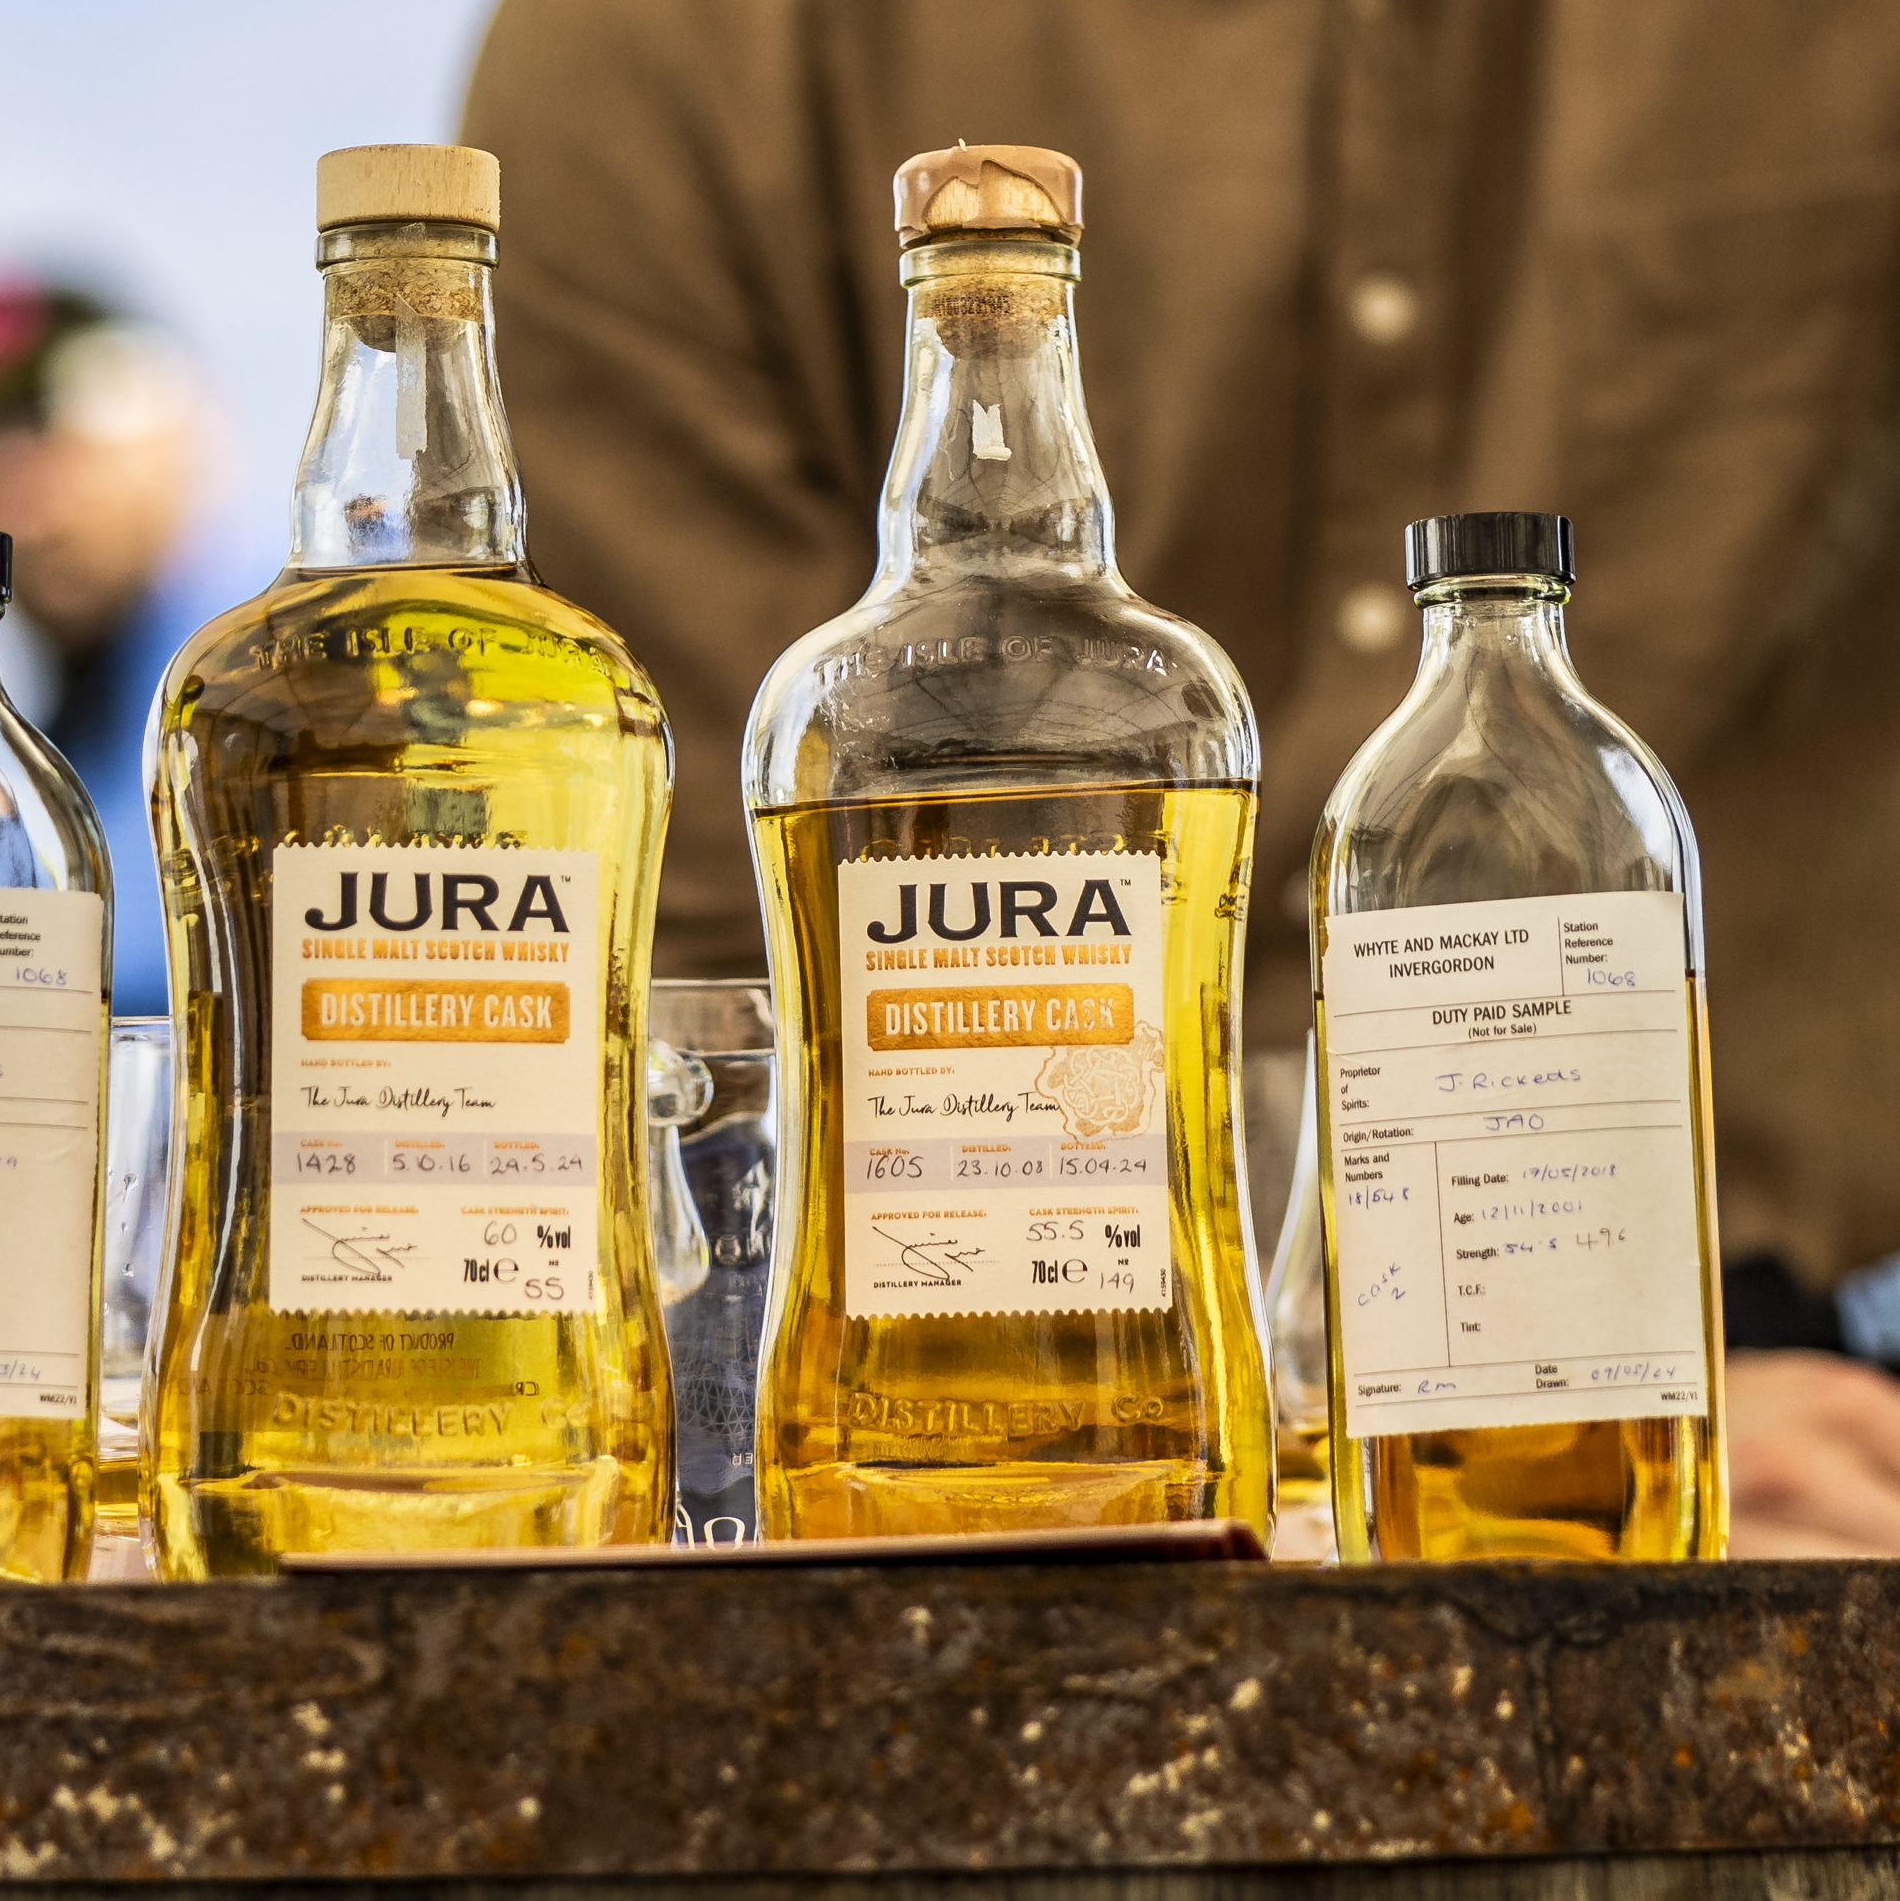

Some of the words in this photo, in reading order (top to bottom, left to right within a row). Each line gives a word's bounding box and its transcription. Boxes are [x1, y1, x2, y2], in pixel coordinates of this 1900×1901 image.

[346, 626, 430, 659] ISLE
[448, 626, 497, 654] OF
[900, 635, 992, 666] ISLE
[1005, 634, 1057, 663] OF
[304, 871, 570, 933] JURA
[867, 879, 1132, 944] JURA
[1563, 921, 1599, 932] Station
[1354, 940, 1399, 958] WHYTE
[1404, 936, 1435, 953] AND
[1439, 931, 1499, 950] MACKAY
[1504, 929, 1529, 945] LTD
[1565, 936, 1613, 948] Reference
[302, 938, 366, 959] SINGLE
[372, 939, 420, 960] MALT
[426, 940, 495, 961] SCOTCH
[501, 941, 570, 962] WHISKY
[866, 949, 927, 971] SINGLE
[934, 948, 980, 969] MALT
[986, 946, 1056, 967] SCOTCH
[1063, 944, 1132, 966] WHISKY
[1566, 953, 1608, 964] Number:
[1389, 956, 1495, 979] INVERGORDON
[1586, 968, 1636, 987] 1068
[321, 992, 474, 1027] DISTILLERY
[483, 994, 552, 1029] CASK
[885, 1000, 1036, 1036] DISTILLERY
[1046, 998, 1115, 1031] CASK
[1432, 1008, 1468, 1025] DUTY
[1474, 1004, 1506, 1021] PAID
[1512, 1000, 1572, 1019] SAMPLE
[1468, 1026, 1490, 1039] (Not
[1493, 1025, 1508, 1036] for
[1511, 1022, 1537, 1036] Sale)
[868, 1069, 893, 1077] HAND
[896, 1067, 938, 1076] BOTTLED
[940, 1067, 955, 1075] BY:
[1340, 1065, 1381, 1079] Proprietor
[1341, 1083, 1349, 1094] of
[301, 1086, 330, 1108] The
[334, 1086, 370, 1108] Jura
[377, 1086, 451, 1117] Distillery
[454, 1087, 496, 1108] Team
[868, 1097, 896, 1118] The
[899, 1095, 935, 1116] Jura
[943, 1093, 1017, 1122] Distillery
[1018, 1091, 1060, 1113] Team
[1341, 1098, 1369, 1112] Spirits:
[1343, 1127, 1414, 1143] Origin/Rotation:
[870, 1148, 892, 1156] CASK
[962, 1145, 1011, 1153] DISTILLED:
[297, 1153, 356, 1174] 1428
[1344, 1154, 1369, 1166] Marks
[1372, 1153, 1390, 1164] and
[867, 1156, 923, 1179] 1605
[1345, 1169, 1383, 1182] Numbers
[1452, 1175, 1481, 1187] Filling
[1483, 1174, 1509, 1184] Date:
[461, 1206, 486, 1214] CASK
[871, 1212, 920, 1221] APPROVED
[922, 1211, 941, 1219] FOR
[944, 1210, 987, 1219] RELEASE:
[1029, 1208, 1052, 1216] CASK
[1055, 1207, 1104, 1215] STRENGTH
[1107, 1206, 1138, 1215] SPIRIT:
[1454, 1213, 1474, 1224] Age:
[483, 1221, 517, 1246] 60
[1456, 1248, 1499, 1260] Strength:
[464, 1258, 489, 1282] 70cl
[1032, 1260, 1058, 1284] 70cl
[301, 1274, 349, 1282] DISTILLERY
[352, 1274, 392, 1282] MANAGER
[873, 1281, 918, 1289] DISTILLERY
[921, 1279, 961, 1287] MANAGER
[1460, 1321, 1481, 1333] Tint:
[1535, 1364, 1557, 1374] Date
[1358, 1382, 1401, 1396] Signature:
[1536, 1378, 1569, 1389] Drawn:
[272, 1393, 513, 1438] DISTILLERY
[847, 1392, 1087, 1438] DISTILLERY
